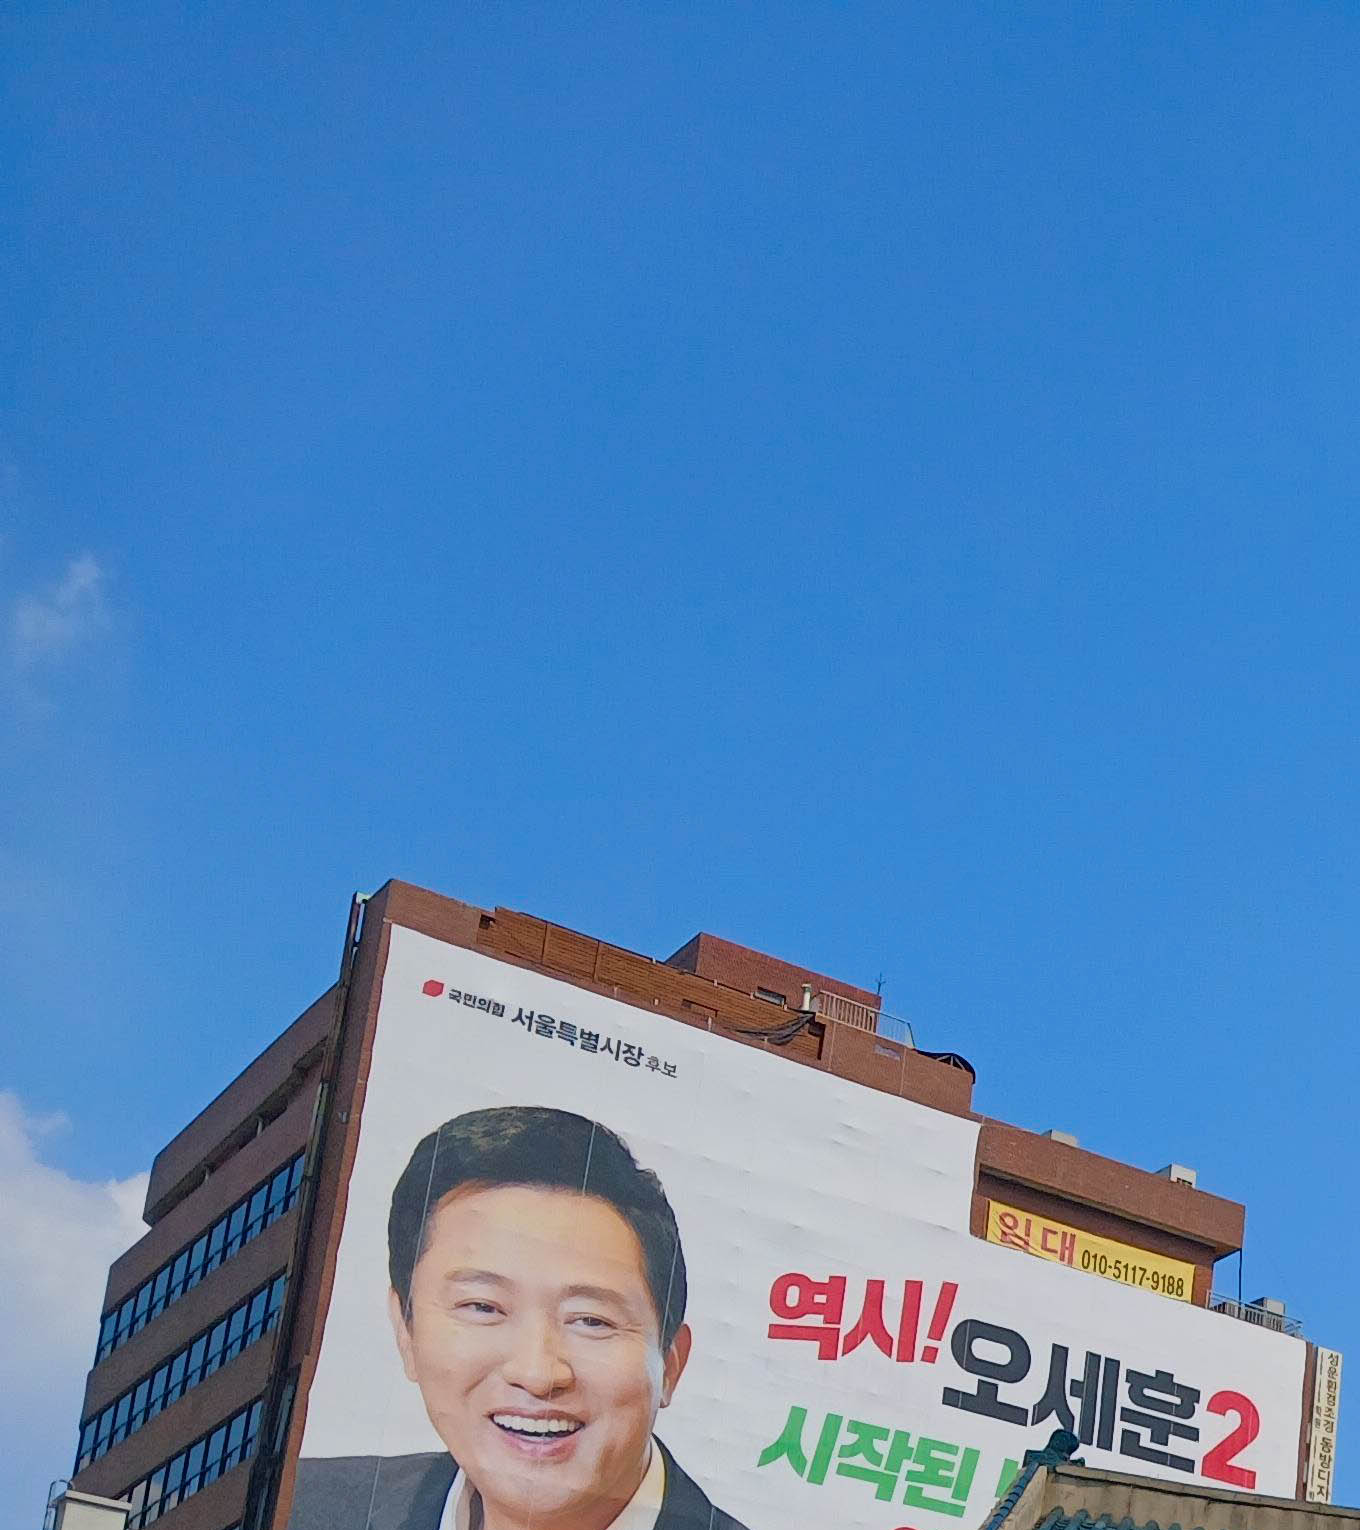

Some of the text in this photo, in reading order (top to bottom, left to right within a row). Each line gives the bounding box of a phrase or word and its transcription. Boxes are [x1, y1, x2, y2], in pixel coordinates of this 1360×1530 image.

[448, 988, 678, 1079] 국민의힘 서울특별시장 후보
[1081, 1249, 1184, 1298] 010-5117-9188
[767, 1272, 959, 1364] 역시!
[941, 1318, 1201, 1474] 오세훈
[756, 1405, 981, 1518] 시작된
